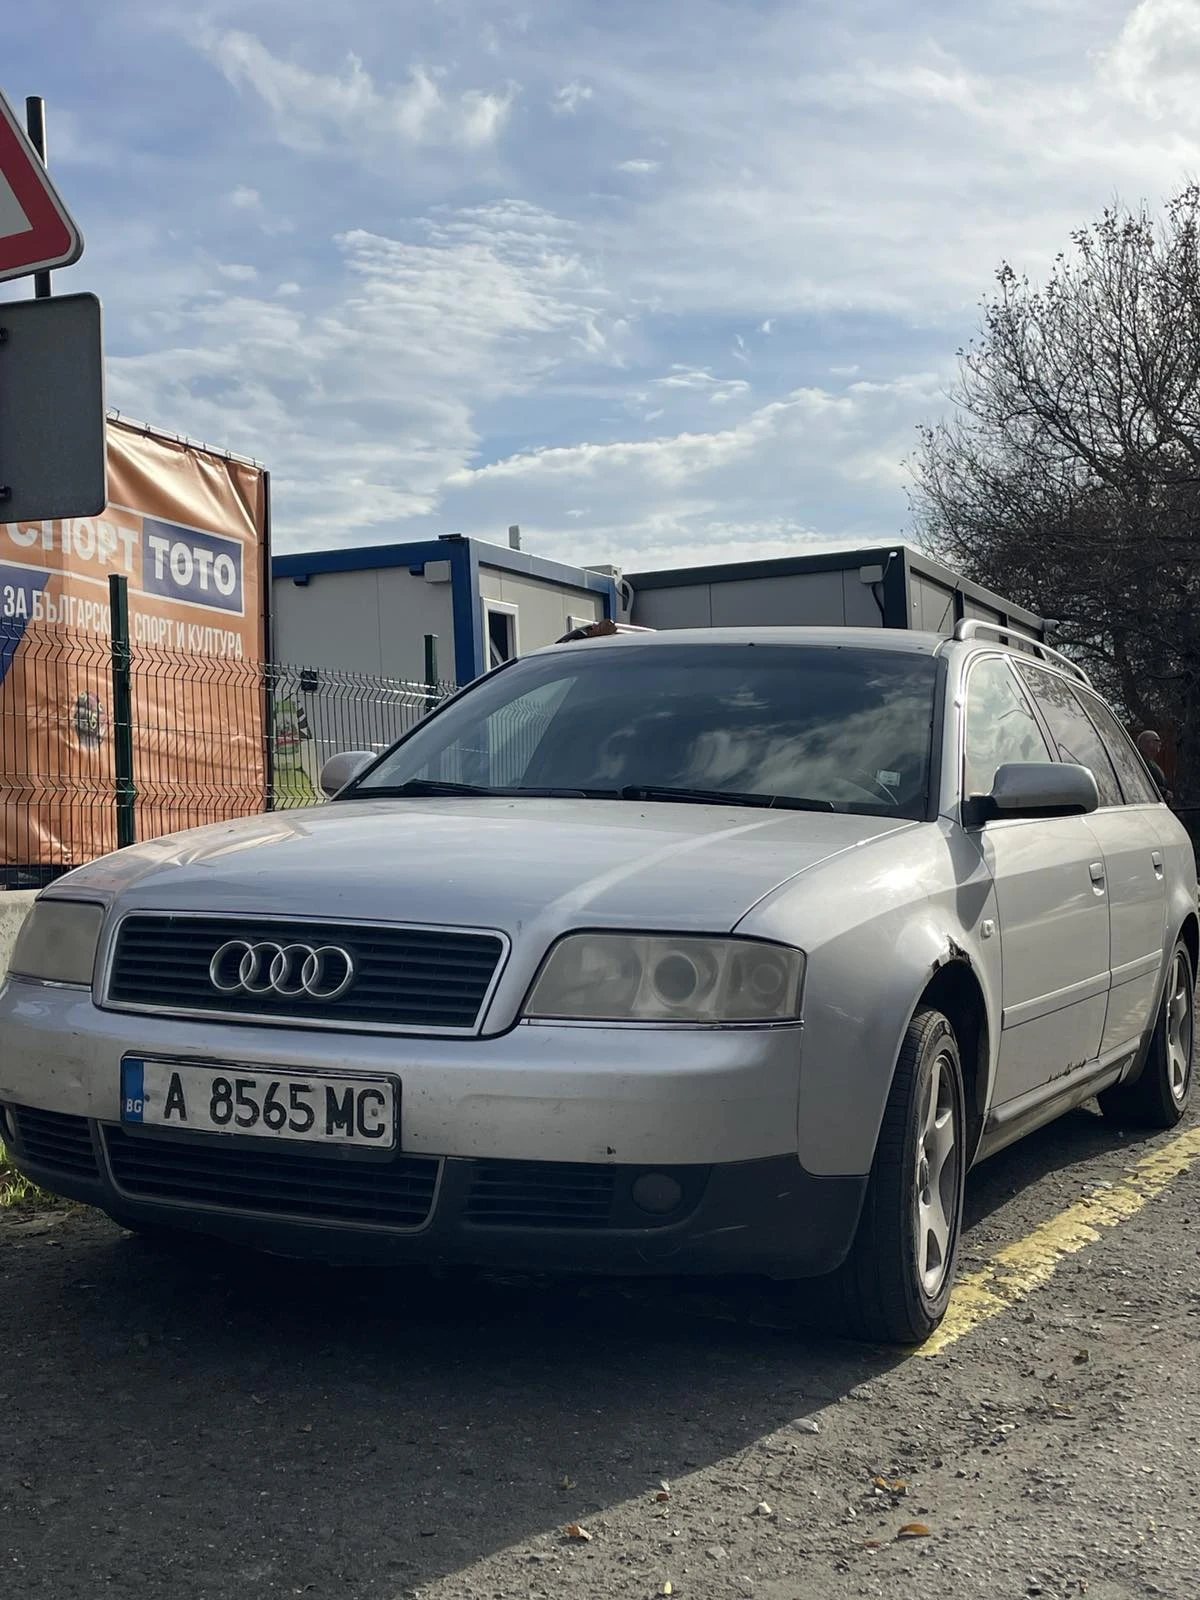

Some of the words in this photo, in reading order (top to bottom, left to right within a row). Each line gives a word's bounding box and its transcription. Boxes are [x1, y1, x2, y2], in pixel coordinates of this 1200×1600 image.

[149, 535, 236, 596] ТОТО
[3, 585, 28, 619] ЗА
[134, 612, 173, 647] СПОРТ
[176, 621, 185, 648] И
[188, 623, 243, 658] КУЛТУРА
[126, 1099, 142, 1113] BG
[163, 1072, 187, 1121] A
[209, 1077, 315, 1133] 8565
[325, 1086, 385, 1138] MC
